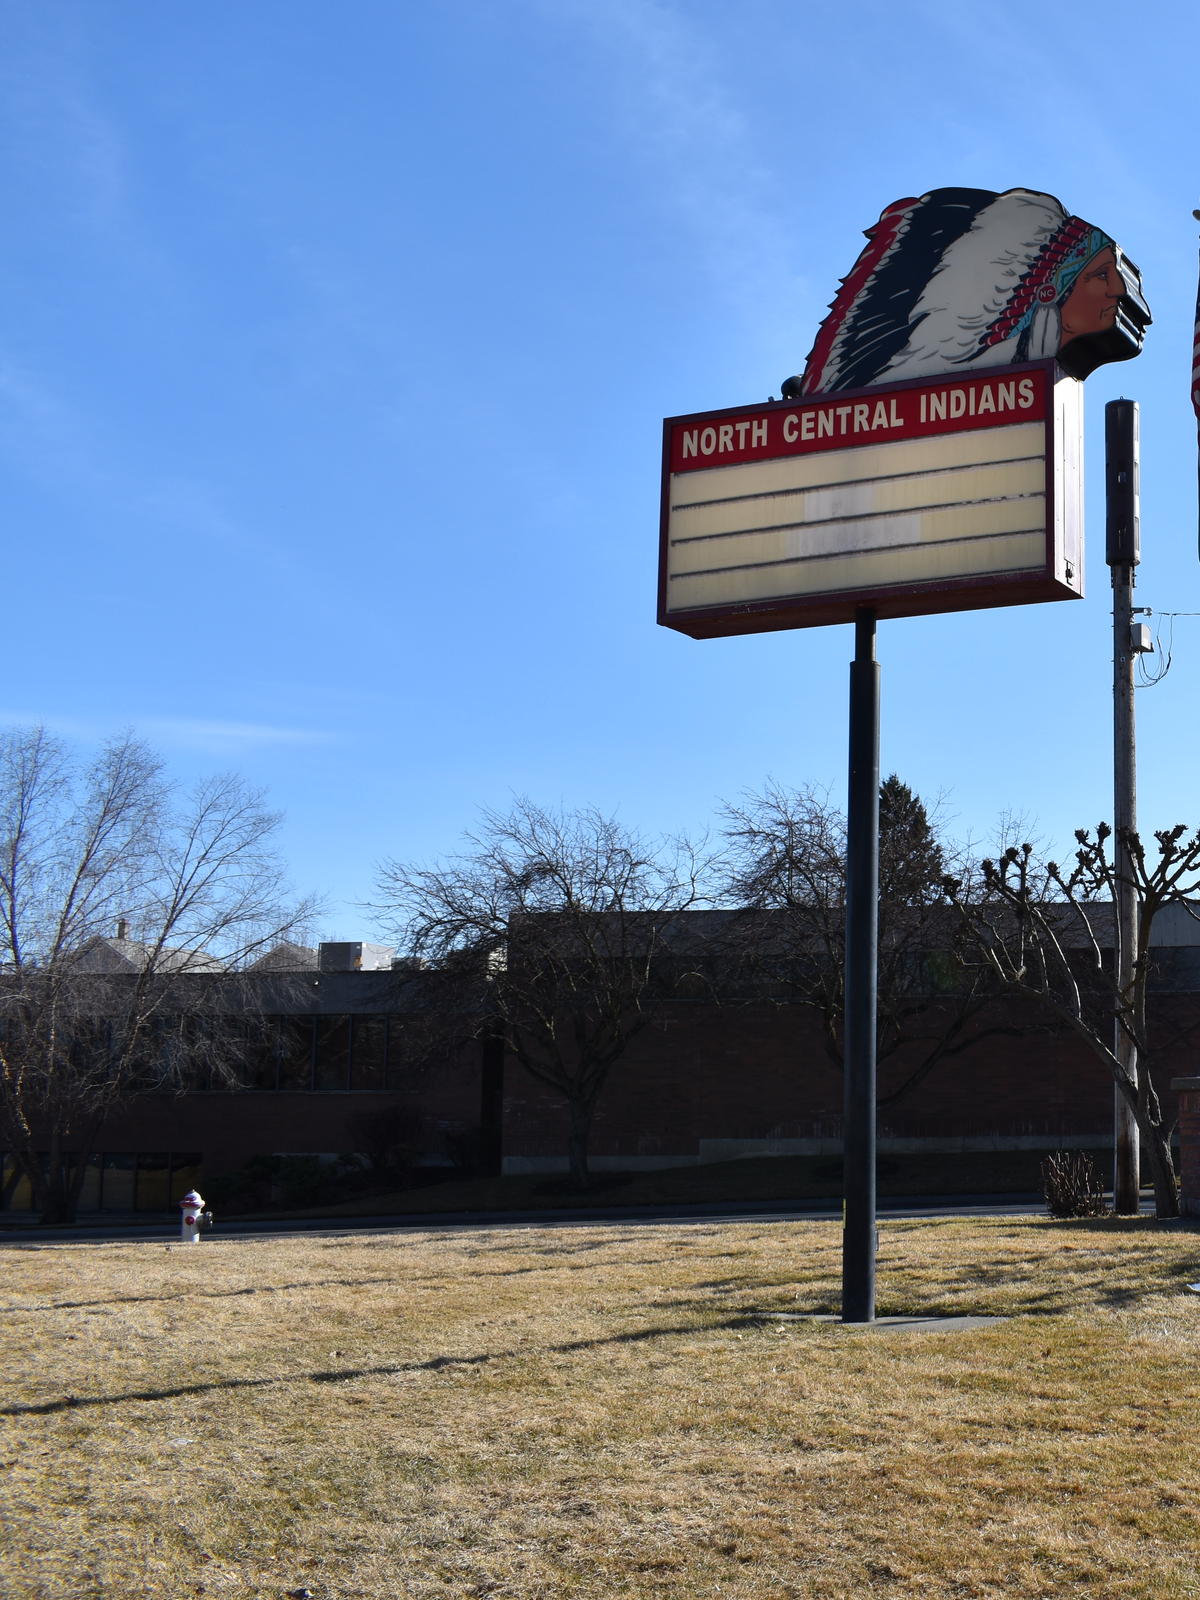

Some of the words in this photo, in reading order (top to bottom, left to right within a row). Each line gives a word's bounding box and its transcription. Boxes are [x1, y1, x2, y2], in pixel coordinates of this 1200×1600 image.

[1040, 289, 1055, 299] NC
[682, 419, 768, 458] NORTH
[783, 399, 904, 443] CENTRAL
[920, 379, 1034, 423] INDIANS
